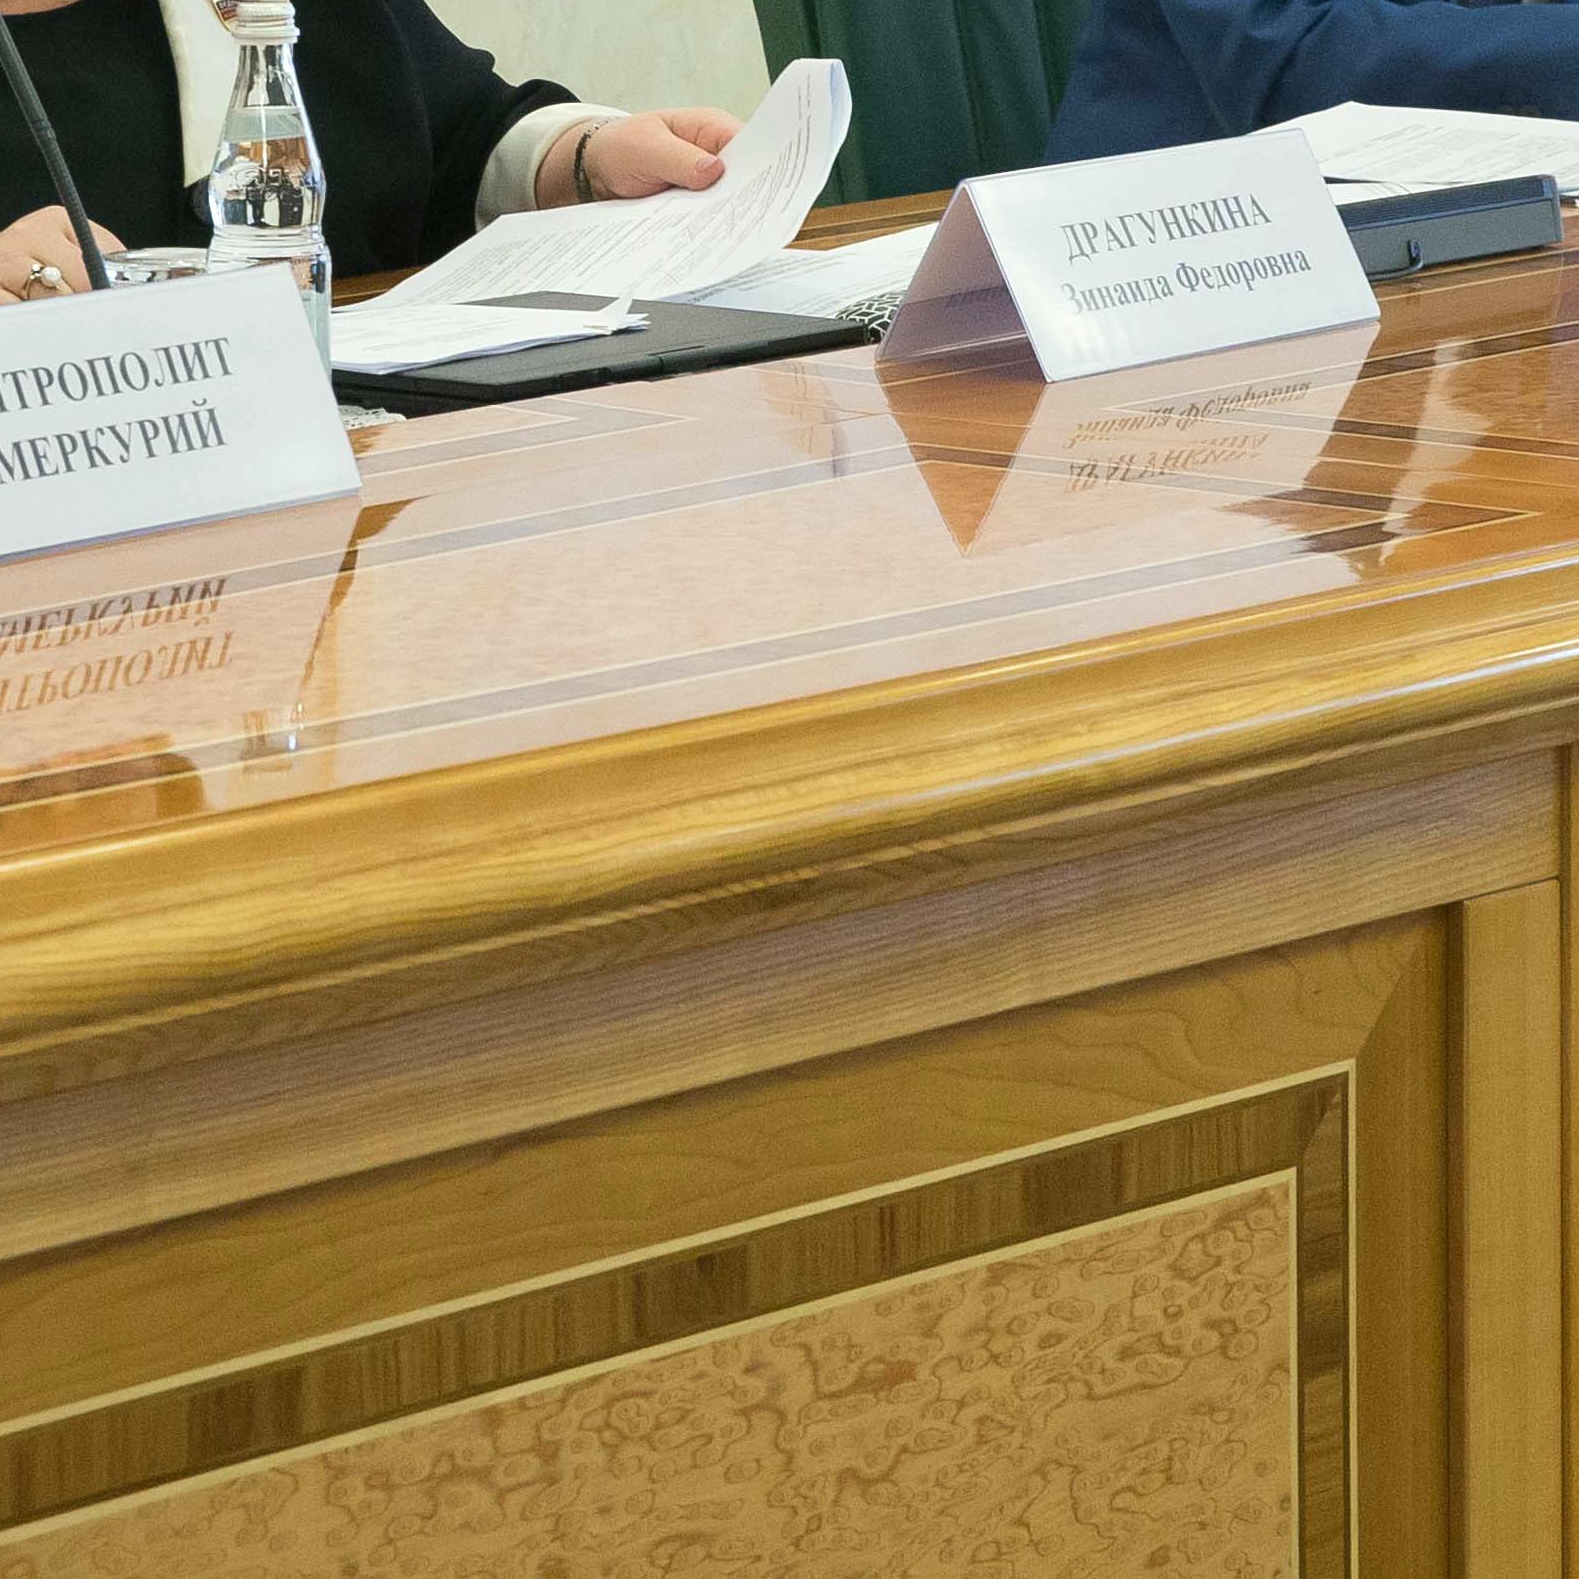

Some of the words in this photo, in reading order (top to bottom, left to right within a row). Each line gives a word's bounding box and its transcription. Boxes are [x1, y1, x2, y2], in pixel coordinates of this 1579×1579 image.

[1060, 193, 1272, 263] ДРАГУНКИНА
[1061, 276, 1175, 318] Зинаида
[1174, 248, 1312, 295] Федоровна
